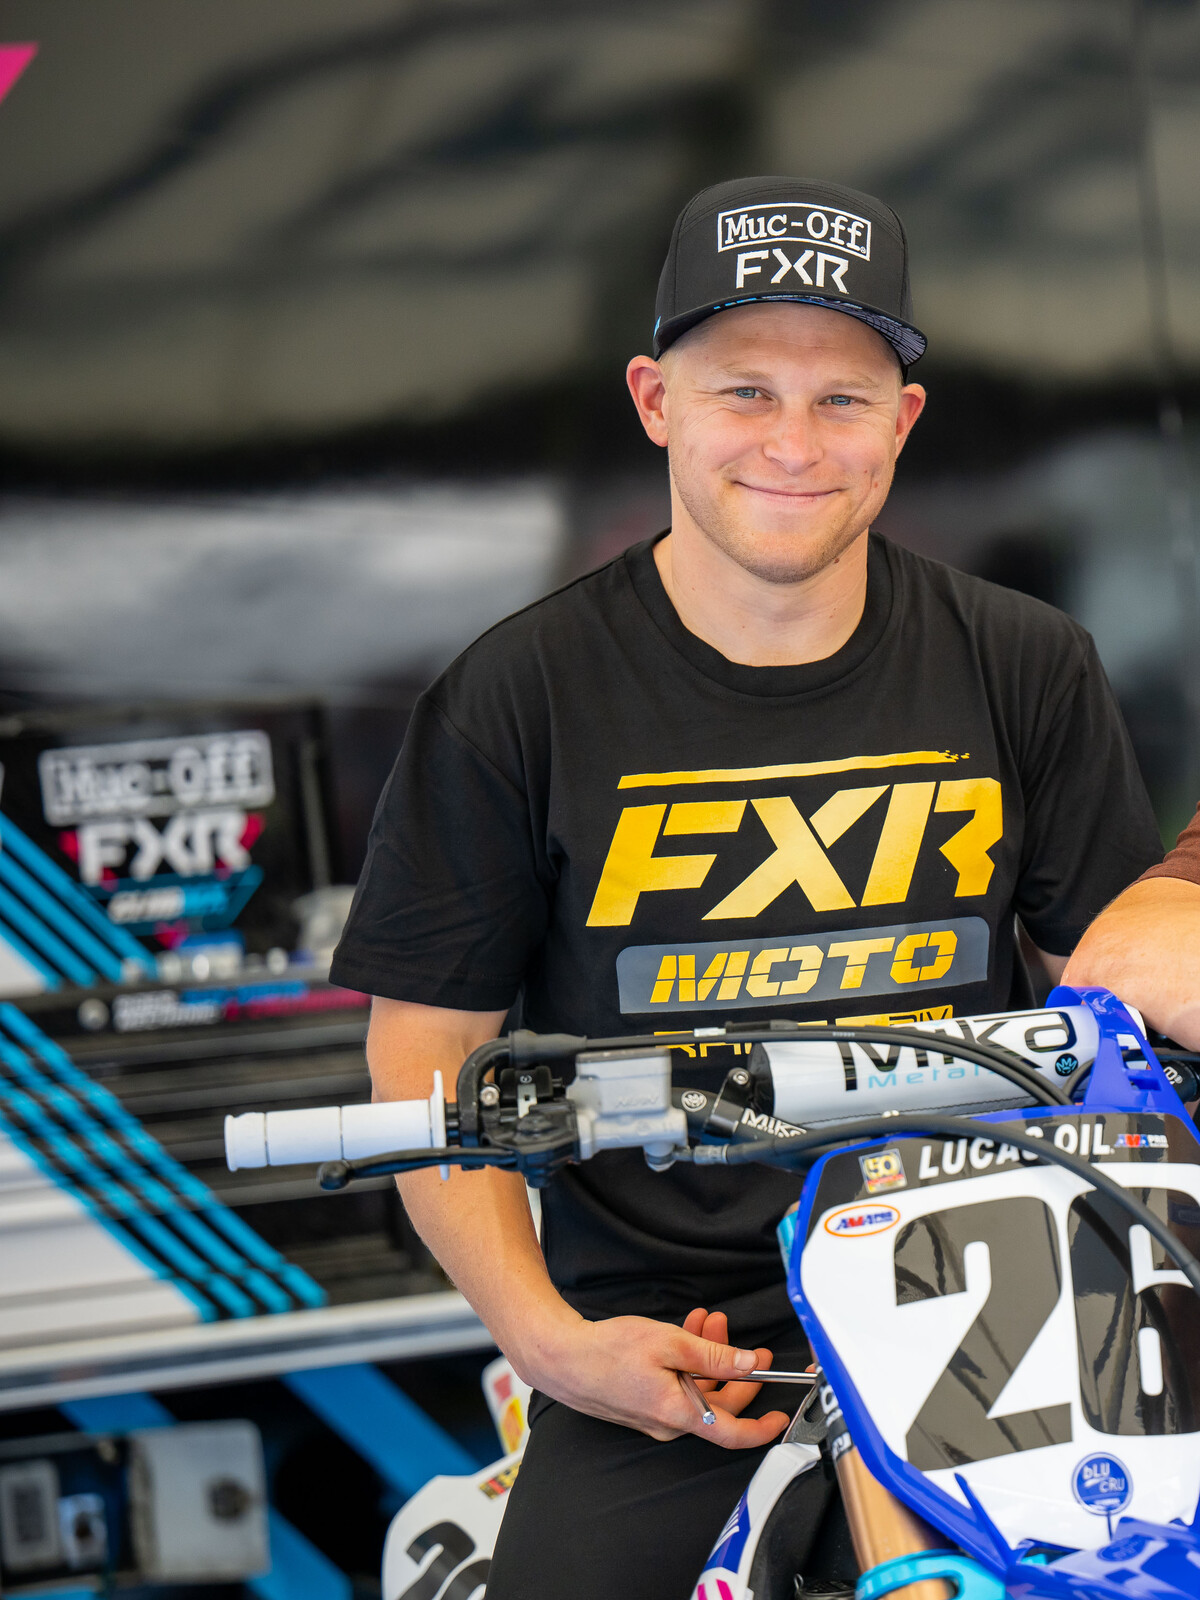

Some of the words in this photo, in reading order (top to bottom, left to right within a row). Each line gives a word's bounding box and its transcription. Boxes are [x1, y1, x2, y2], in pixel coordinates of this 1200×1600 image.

[725, 211, 863, 252] Muc-Off
[736, 248, 849, 294] FXR
[78, 812, 251, 886] FXR
[586, 777, 1004, 927] FXR
[650, 930, 958, 1003] MOTO
[864, 1153, 901, 1181] 50
